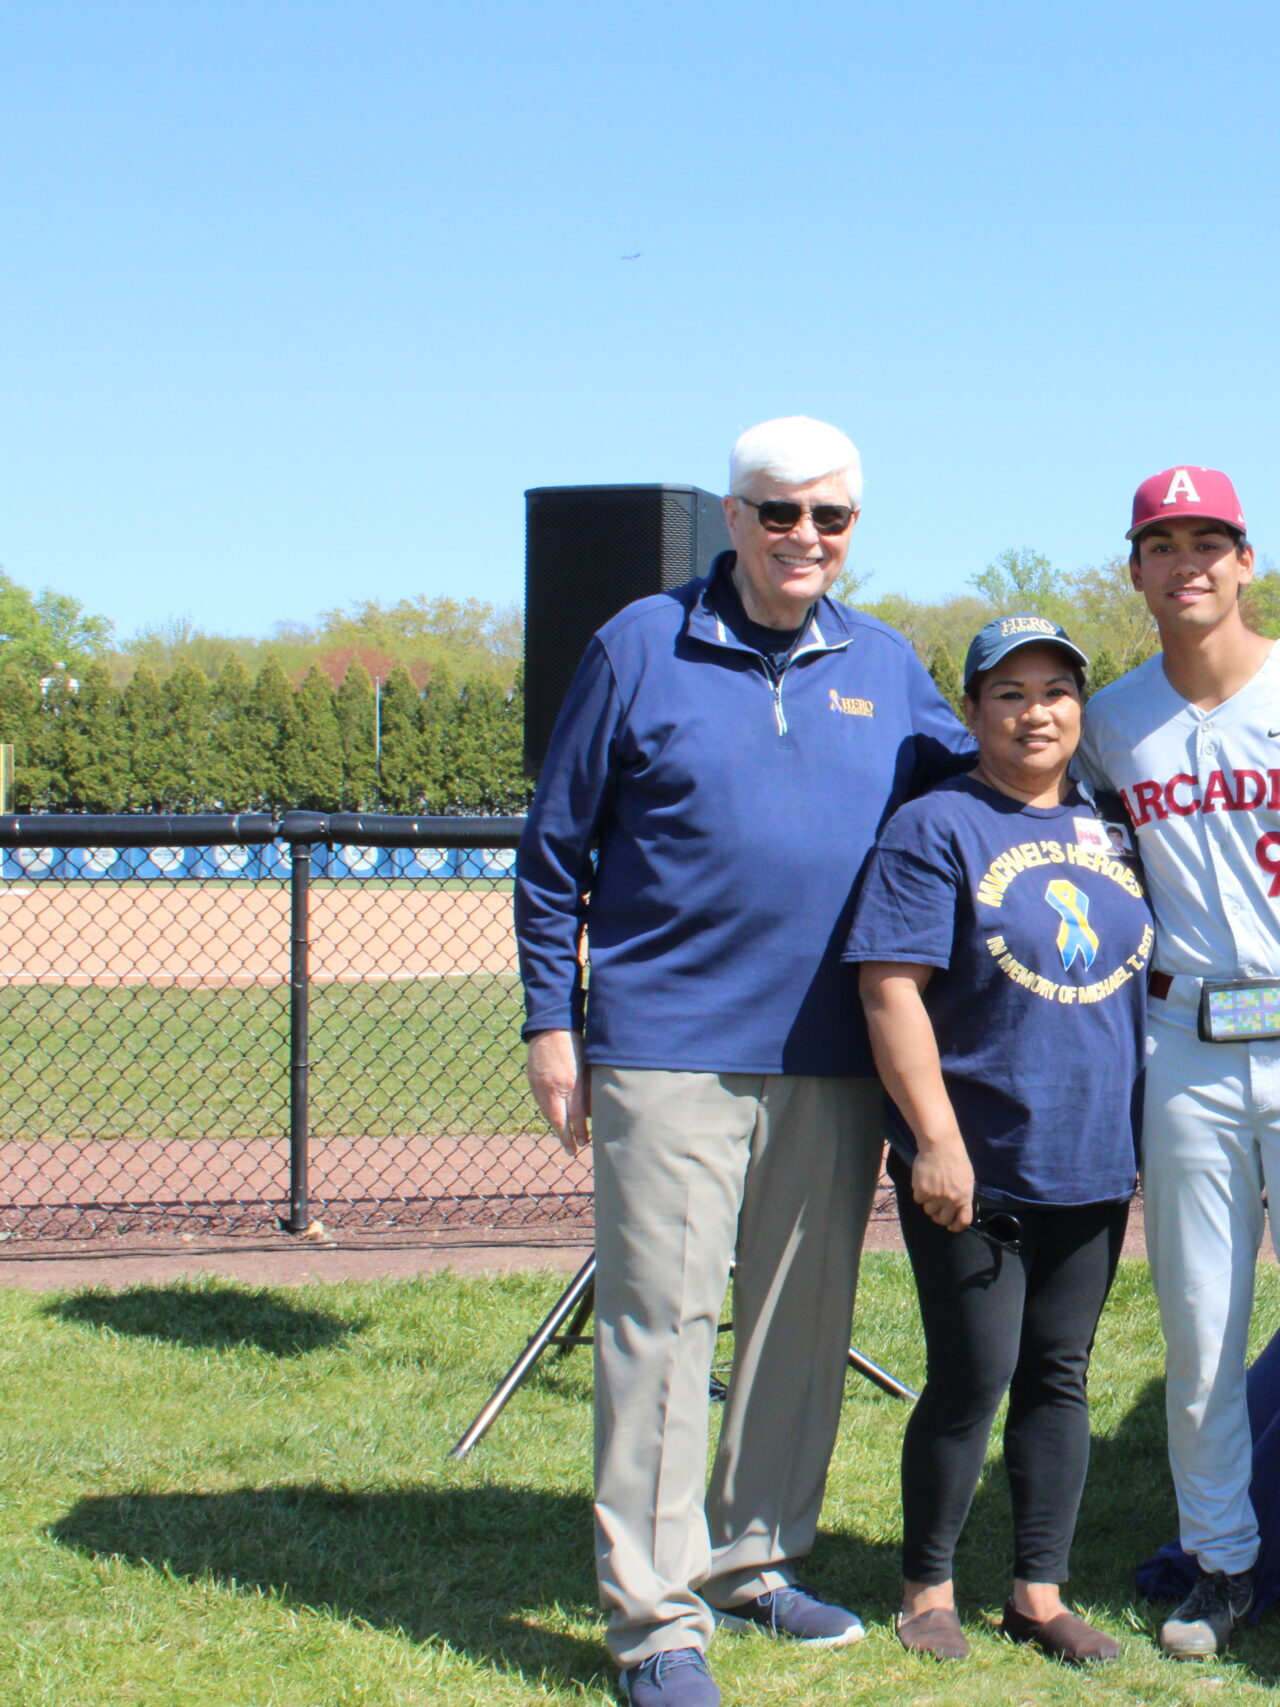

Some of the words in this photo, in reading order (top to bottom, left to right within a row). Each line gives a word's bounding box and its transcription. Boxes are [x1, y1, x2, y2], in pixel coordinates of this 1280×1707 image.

[1161, 468, 1200, 504] A
[1001, 617, 1055, 632] HERO
[840, 697, 873, 713] HERO
[976, 840, 1066, 908] MICHAEL'S
[1066, 842, 1144, 899] HEROES
[986, 935, 1008, 958] IN
[997, 953, 1060, 1001] MEMORY
[1058, 986, 1078, 1004] OF
[1078, 965, 1134, 1005] MICHAEL
[1127, 954, 1145, 971] T.
[1137, 923, 1155, 959] SOT
